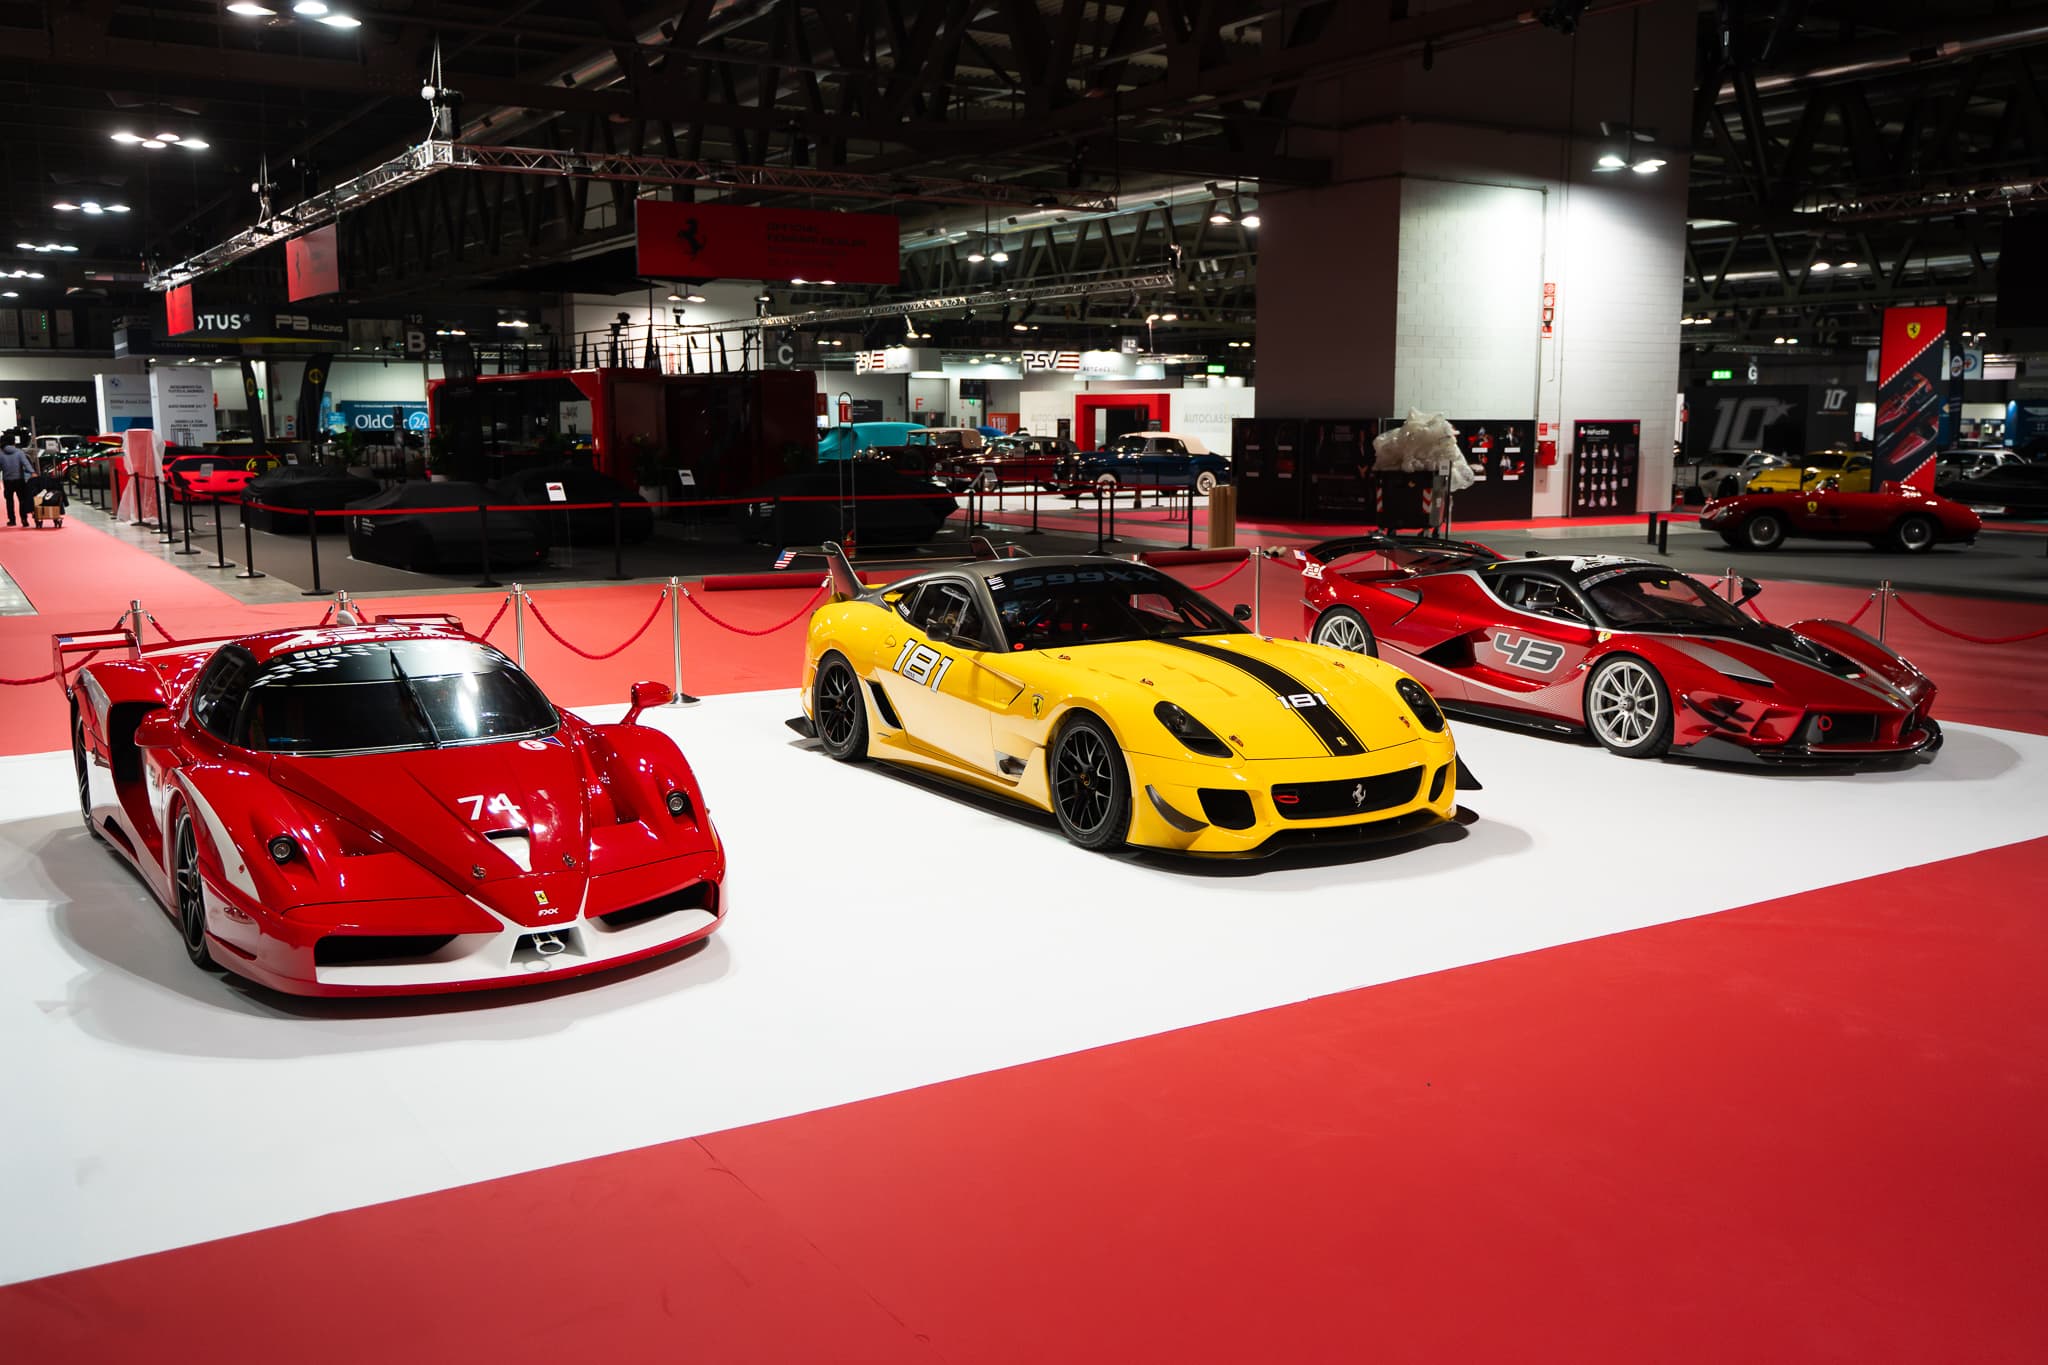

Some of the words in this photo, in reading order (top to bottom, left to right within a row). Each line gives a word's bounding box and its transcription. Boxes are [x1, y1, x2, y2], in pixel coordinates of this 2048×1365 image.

[407, 331, 426, 353] B
[777, 345, 794, 365] C
[1747, 366, 1758, 380] G
[41, 395, 87, 404] FASSINA
[915, 397, 924, 411] F
[354, 413, 408, 429] OldCr
[1709, 397, 1784, 451] 10
[1013, 570, 1160, 591] 599XX
[1493, 632, 1566, 674] 43
[893, 638, 954, 694] 181
[1276, 692, 1328, 710] 181
[456, 793, 528, 828] 74
[538, 907, 559, 917] FXX
